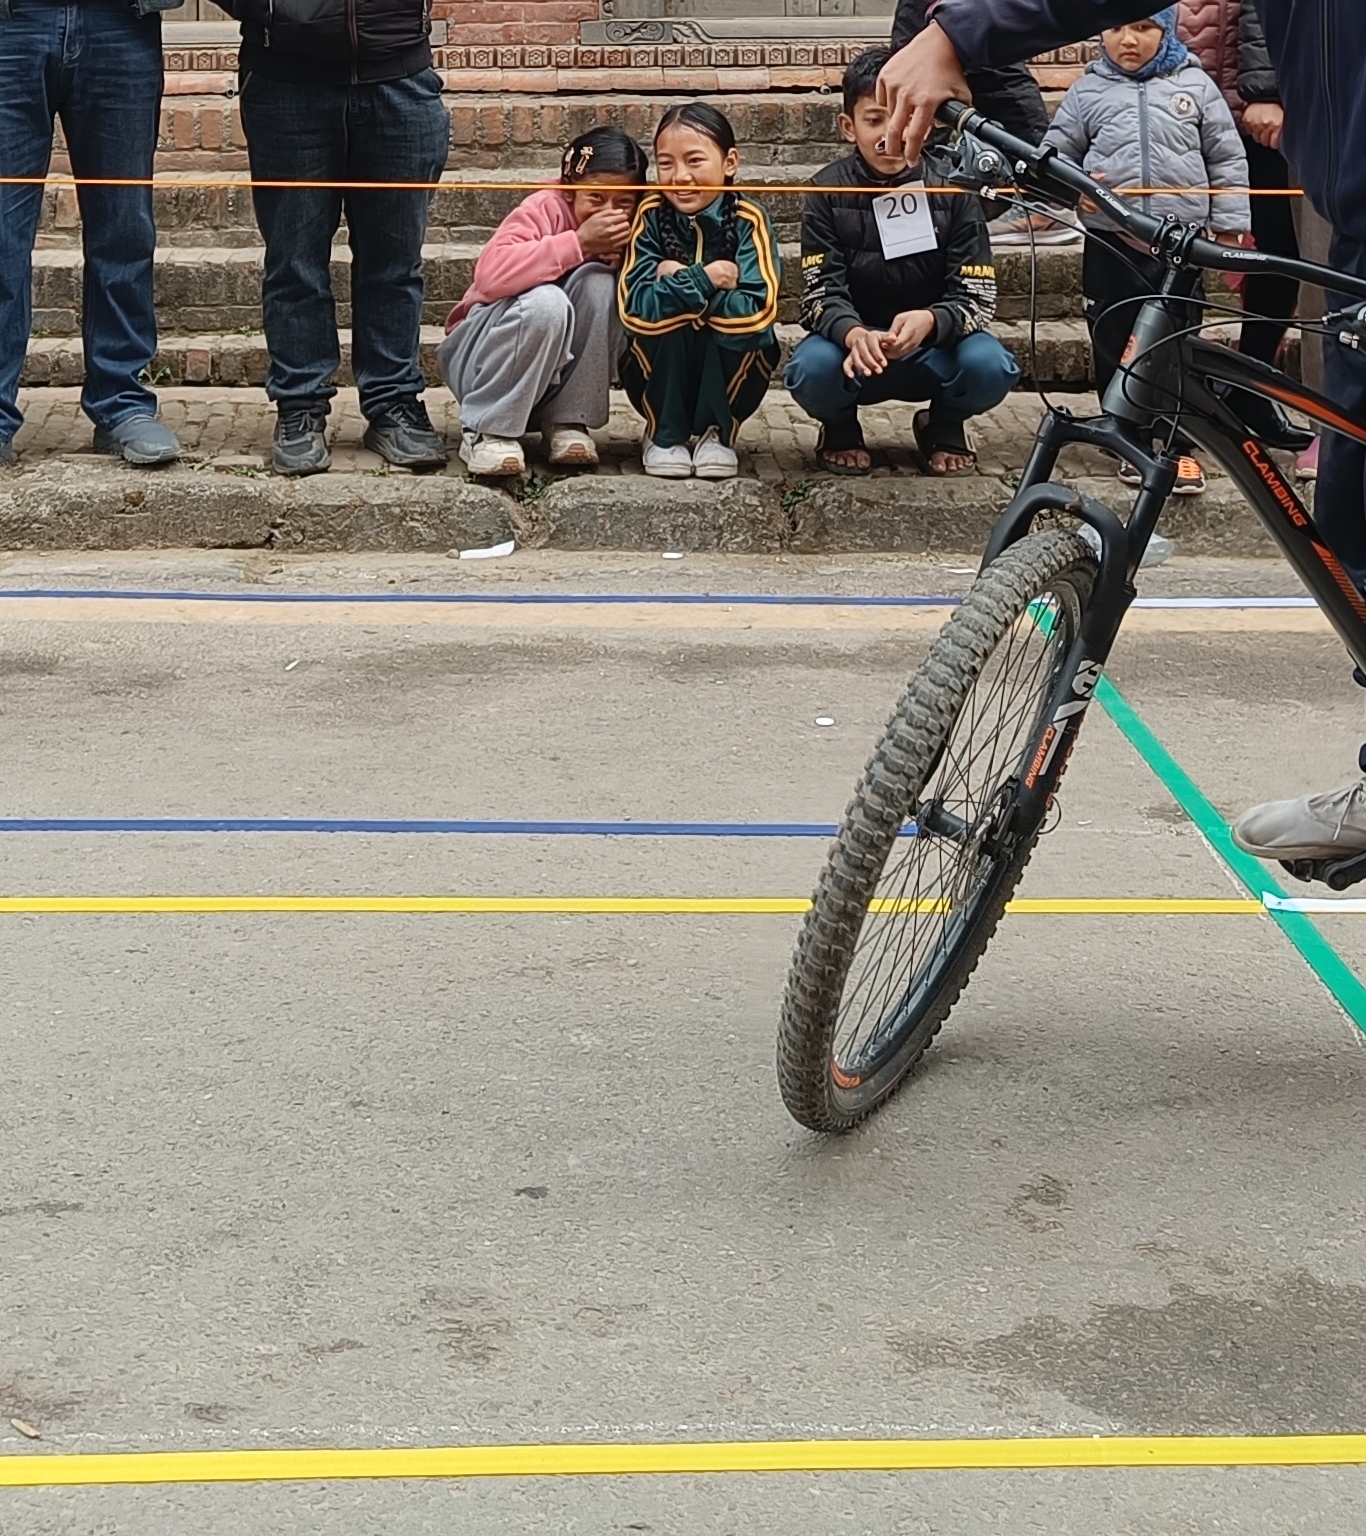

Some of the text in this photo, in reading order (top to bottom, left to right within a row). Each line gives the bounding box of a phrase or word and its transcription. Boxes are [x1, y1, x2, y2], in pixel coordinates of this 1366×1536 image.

[883, 193, 917, 219] 20
[1243, 440, 1307, 526] CLAMBING
[1025, 726, 1054, 788] CLAMBING
